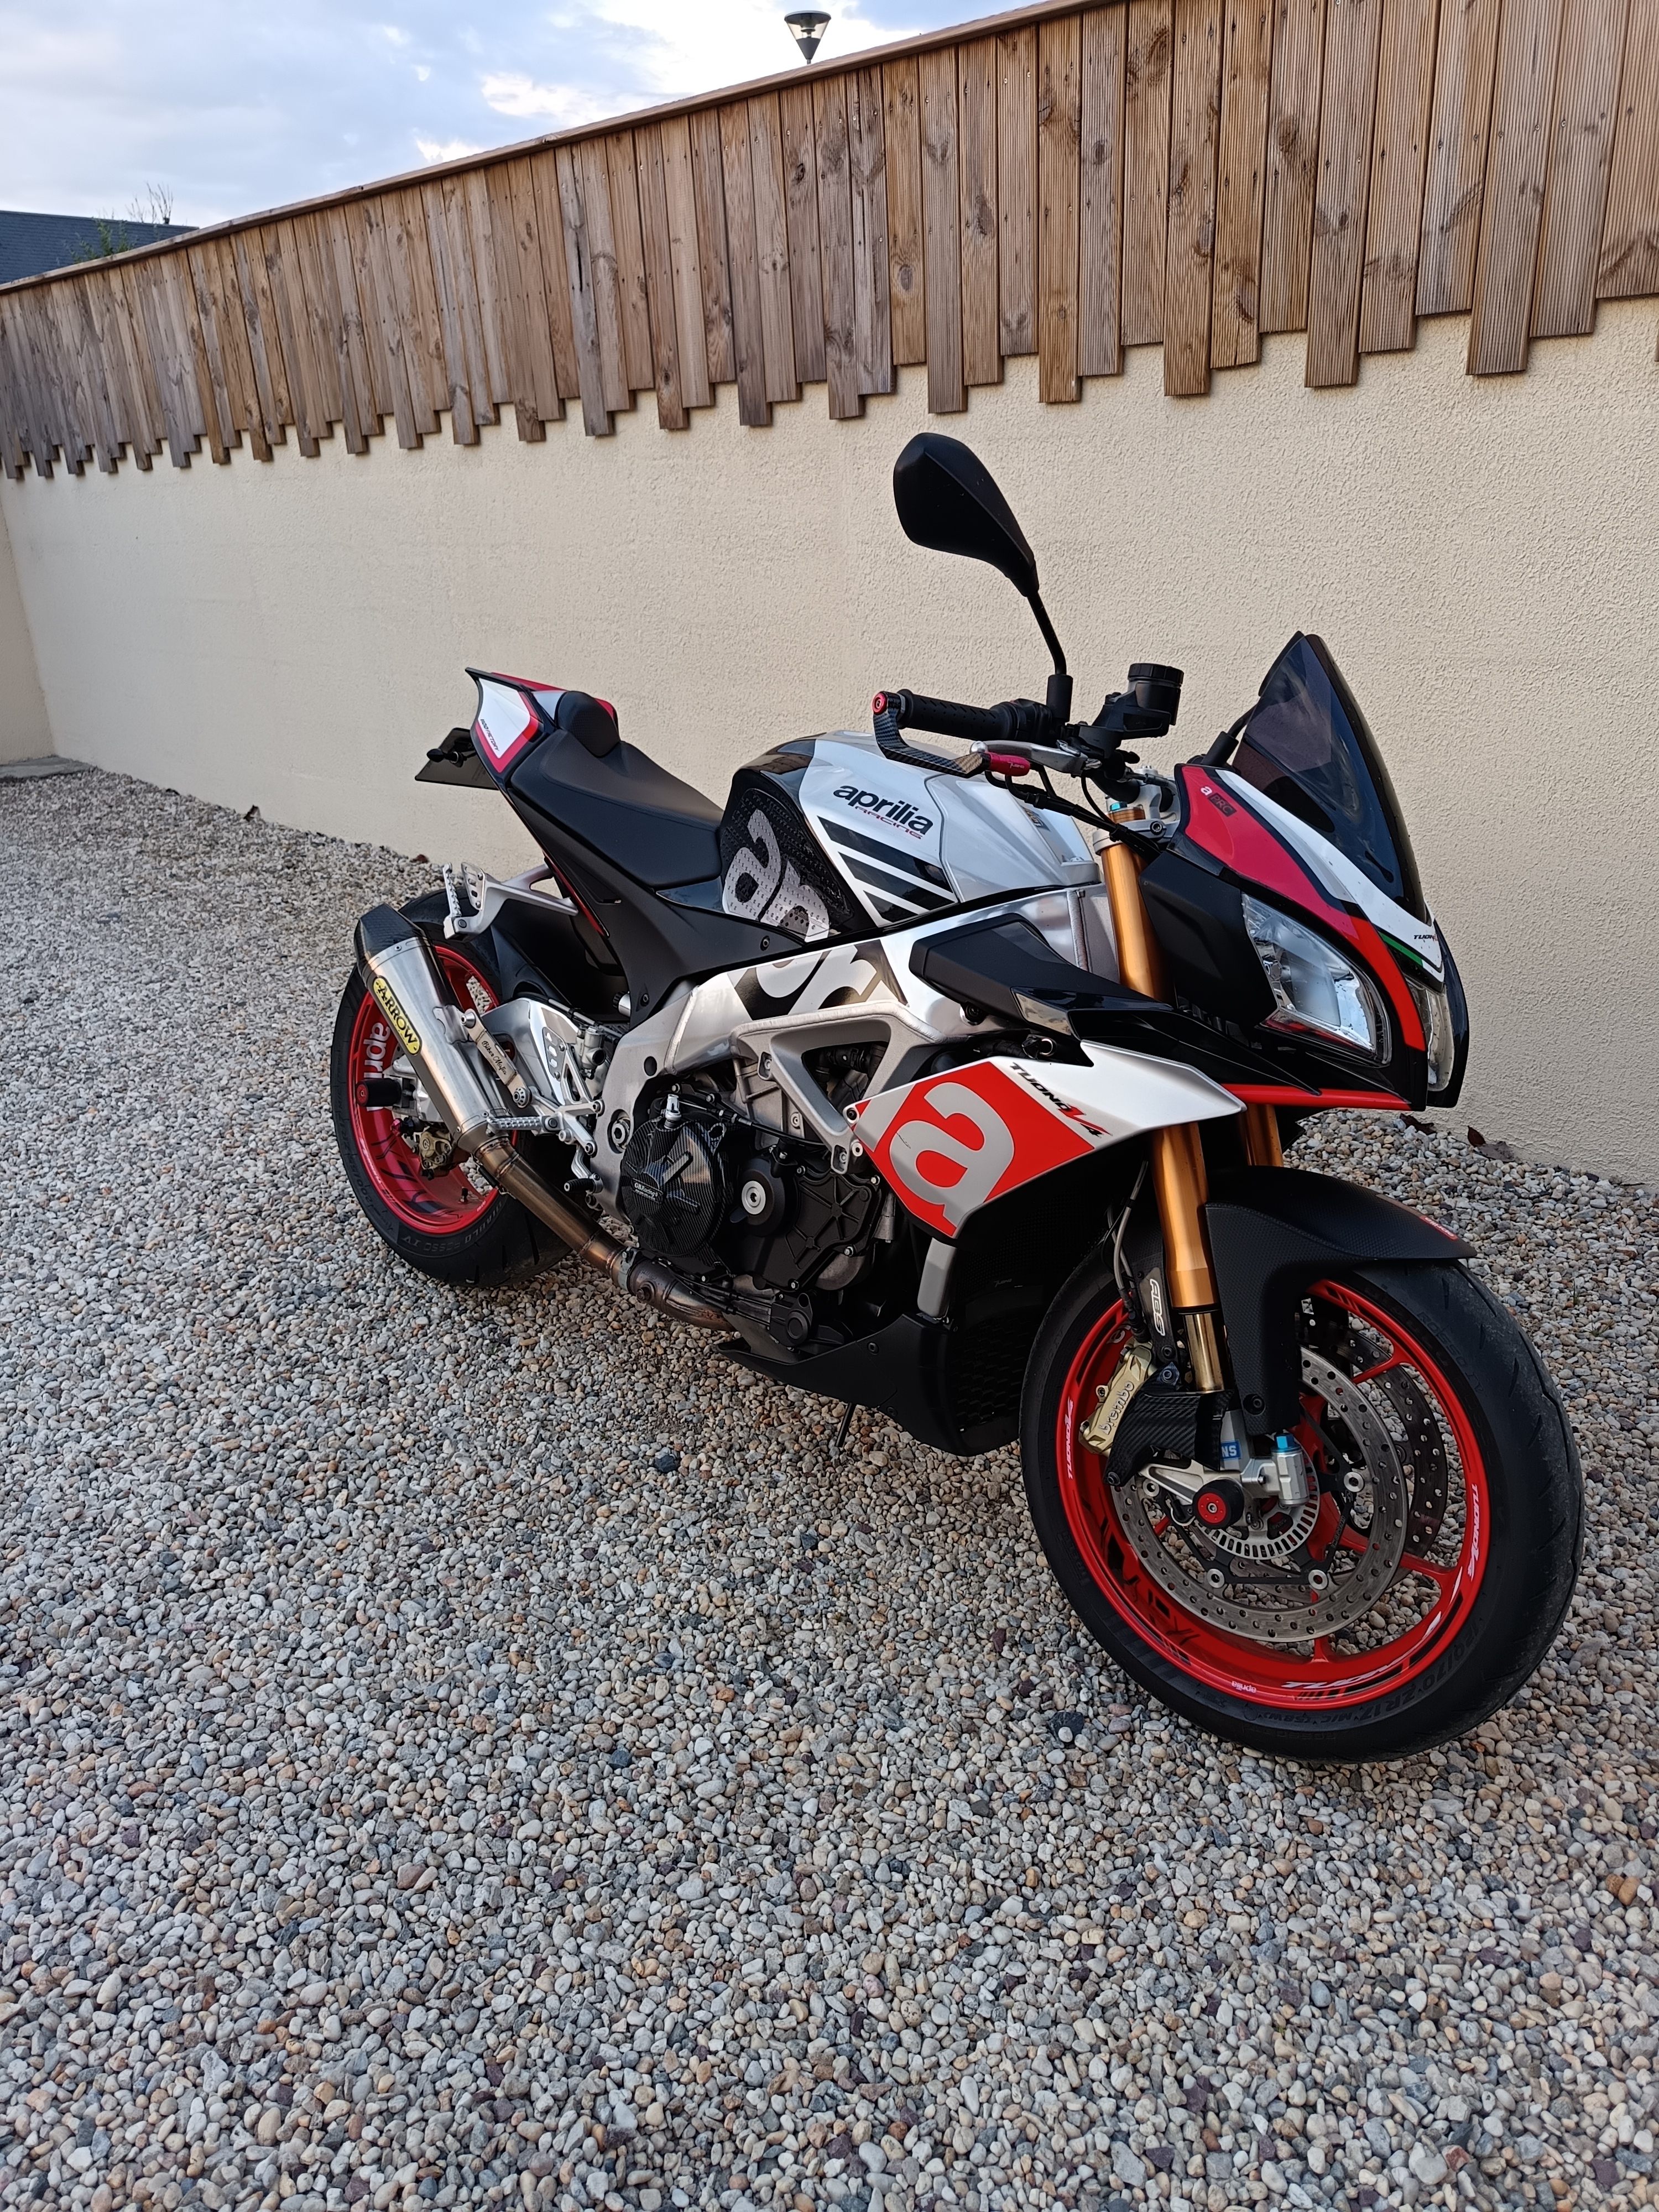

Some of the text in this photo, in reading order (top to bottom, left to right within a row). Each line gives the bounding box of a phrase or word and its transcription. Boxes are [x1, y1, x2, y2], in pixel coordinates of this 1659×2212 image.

[833, 785, 933, 835] aprilia
[378, 986, 418, 1044] ARROW
[1150, 1279, 1165, 1336] ABS
[1098, 1380, 1135, 1436] brembo
